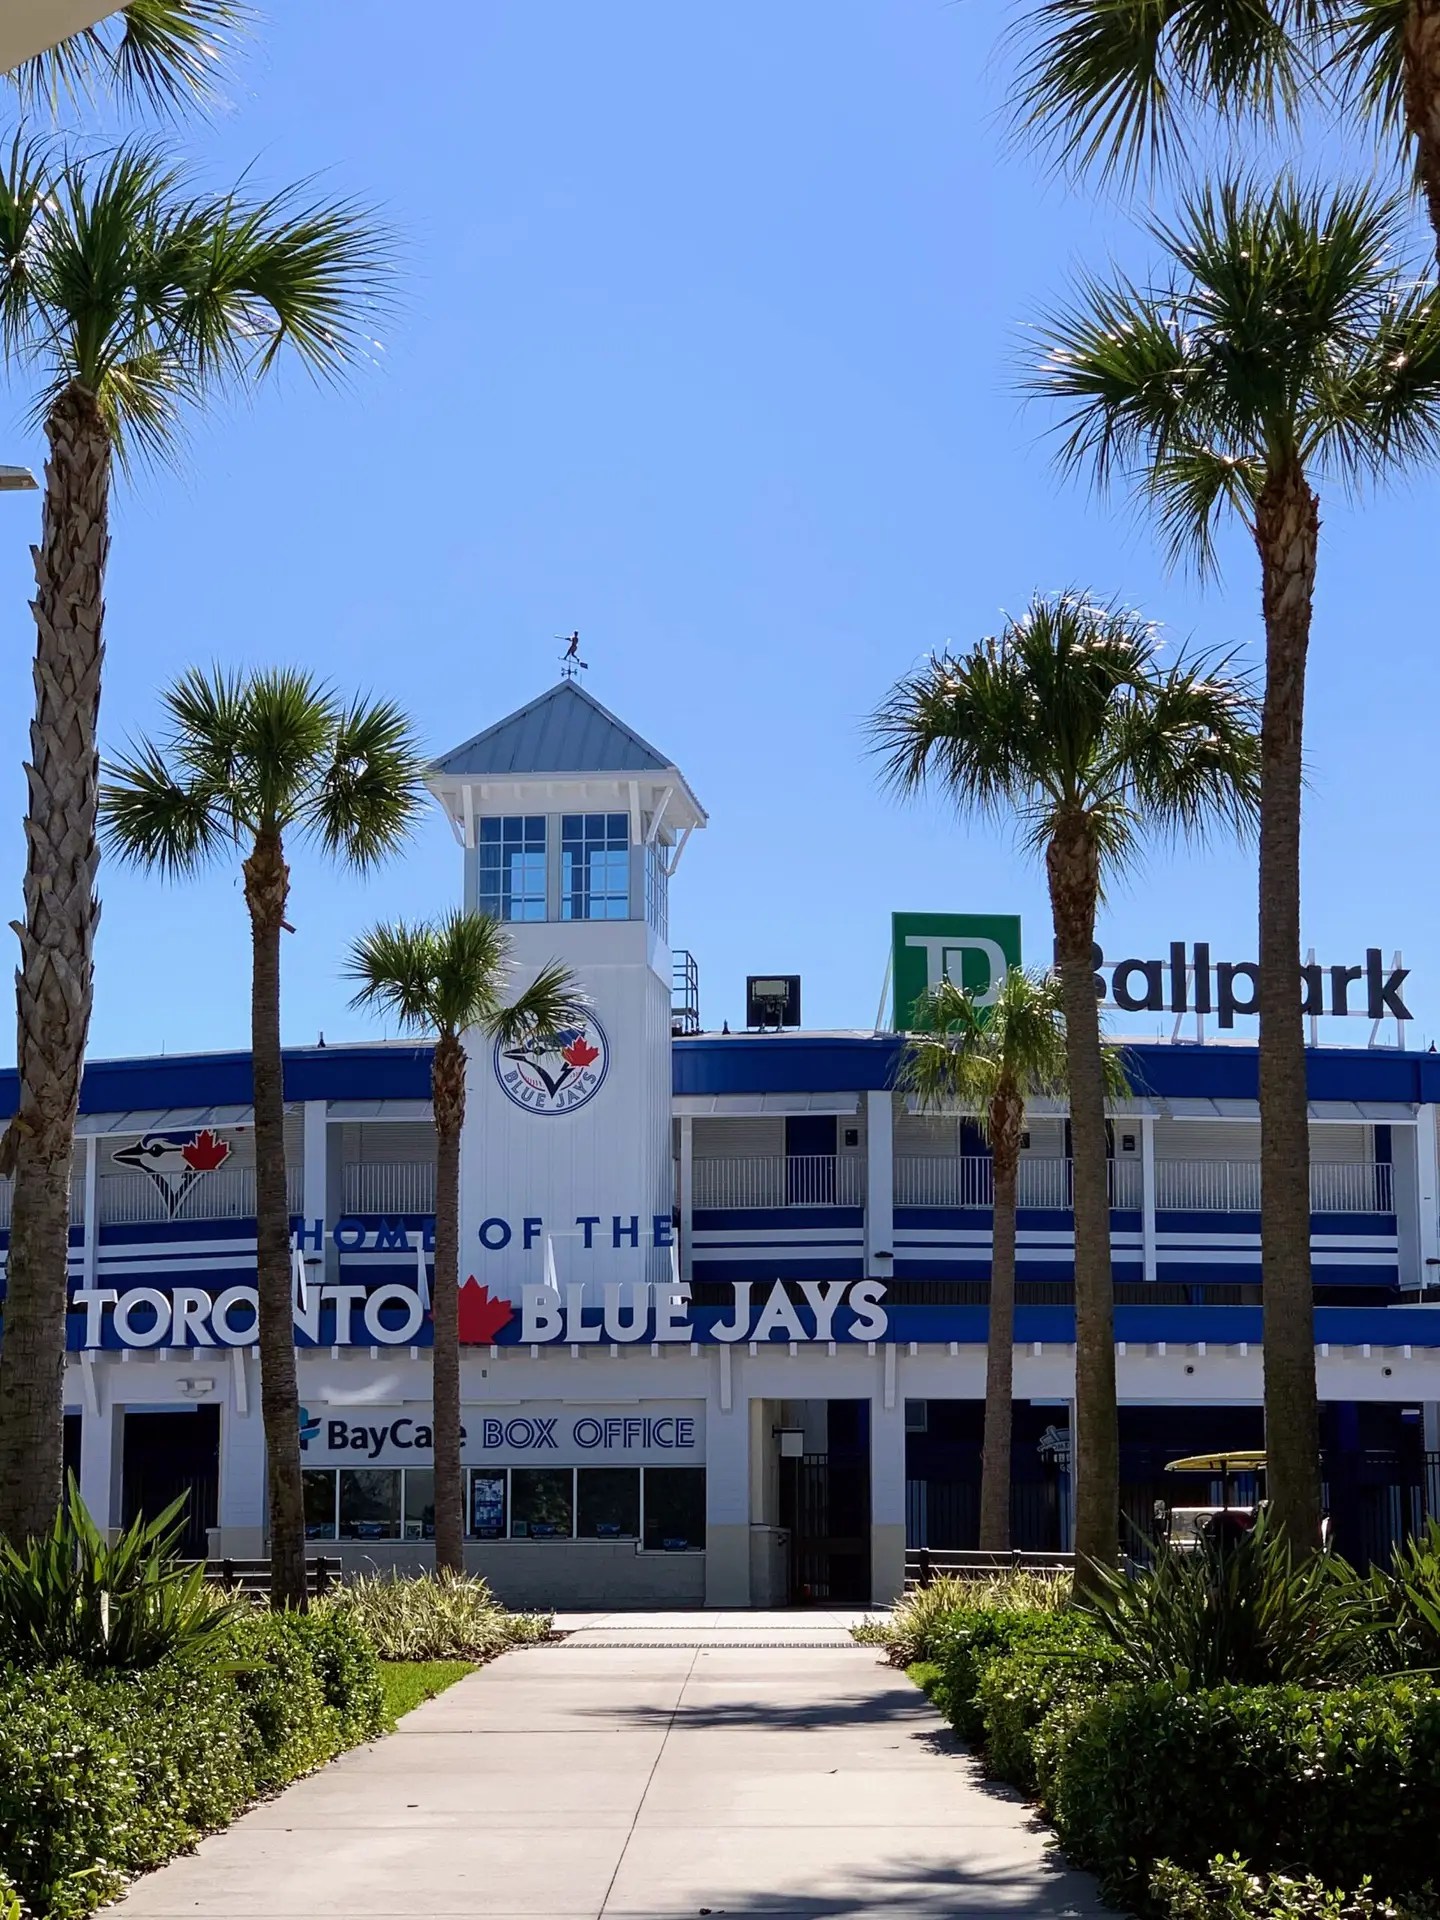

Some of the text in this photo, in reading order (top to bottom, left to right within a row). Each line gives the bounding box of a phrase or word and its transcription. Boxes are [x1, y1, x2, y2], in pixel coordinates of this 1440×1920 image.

[904, 935, 1008, 1007] TD
[503, 1070, 597, 1108] BLUE JAYS
[297, 1215, 673, 1251] HOME OF THE
[72, 1277, 889, 1348] TORONTO BLUE JAYS
[327, 1416, 695, 1459] BayCa BOX OFFICE
